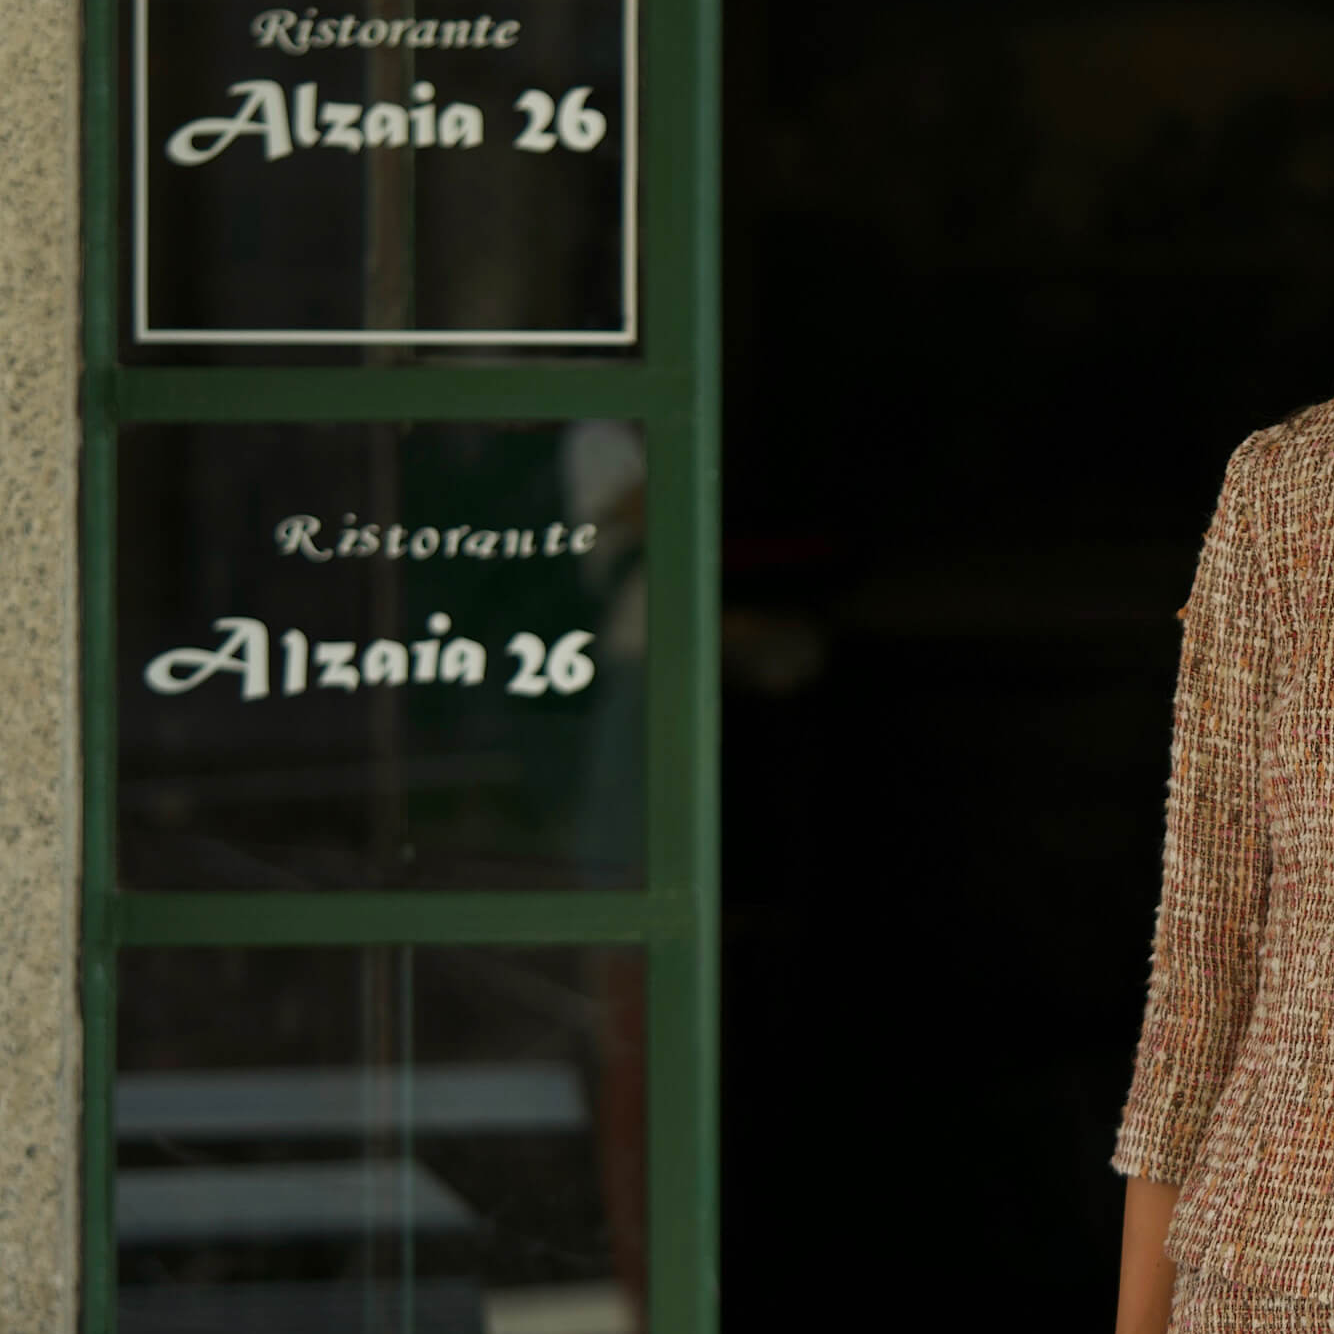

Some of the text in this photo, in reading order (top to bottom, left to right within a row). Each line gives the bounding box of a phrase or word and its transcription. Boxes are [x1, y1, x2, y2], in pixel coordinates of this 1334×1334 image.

[252, 7, 522, 55] Ristorante
[167, 79, 607, 165] Alzaia 26
[275, 512, 598, 561] Ristorante
[144, 611, 596, 701] Alzaia 26
